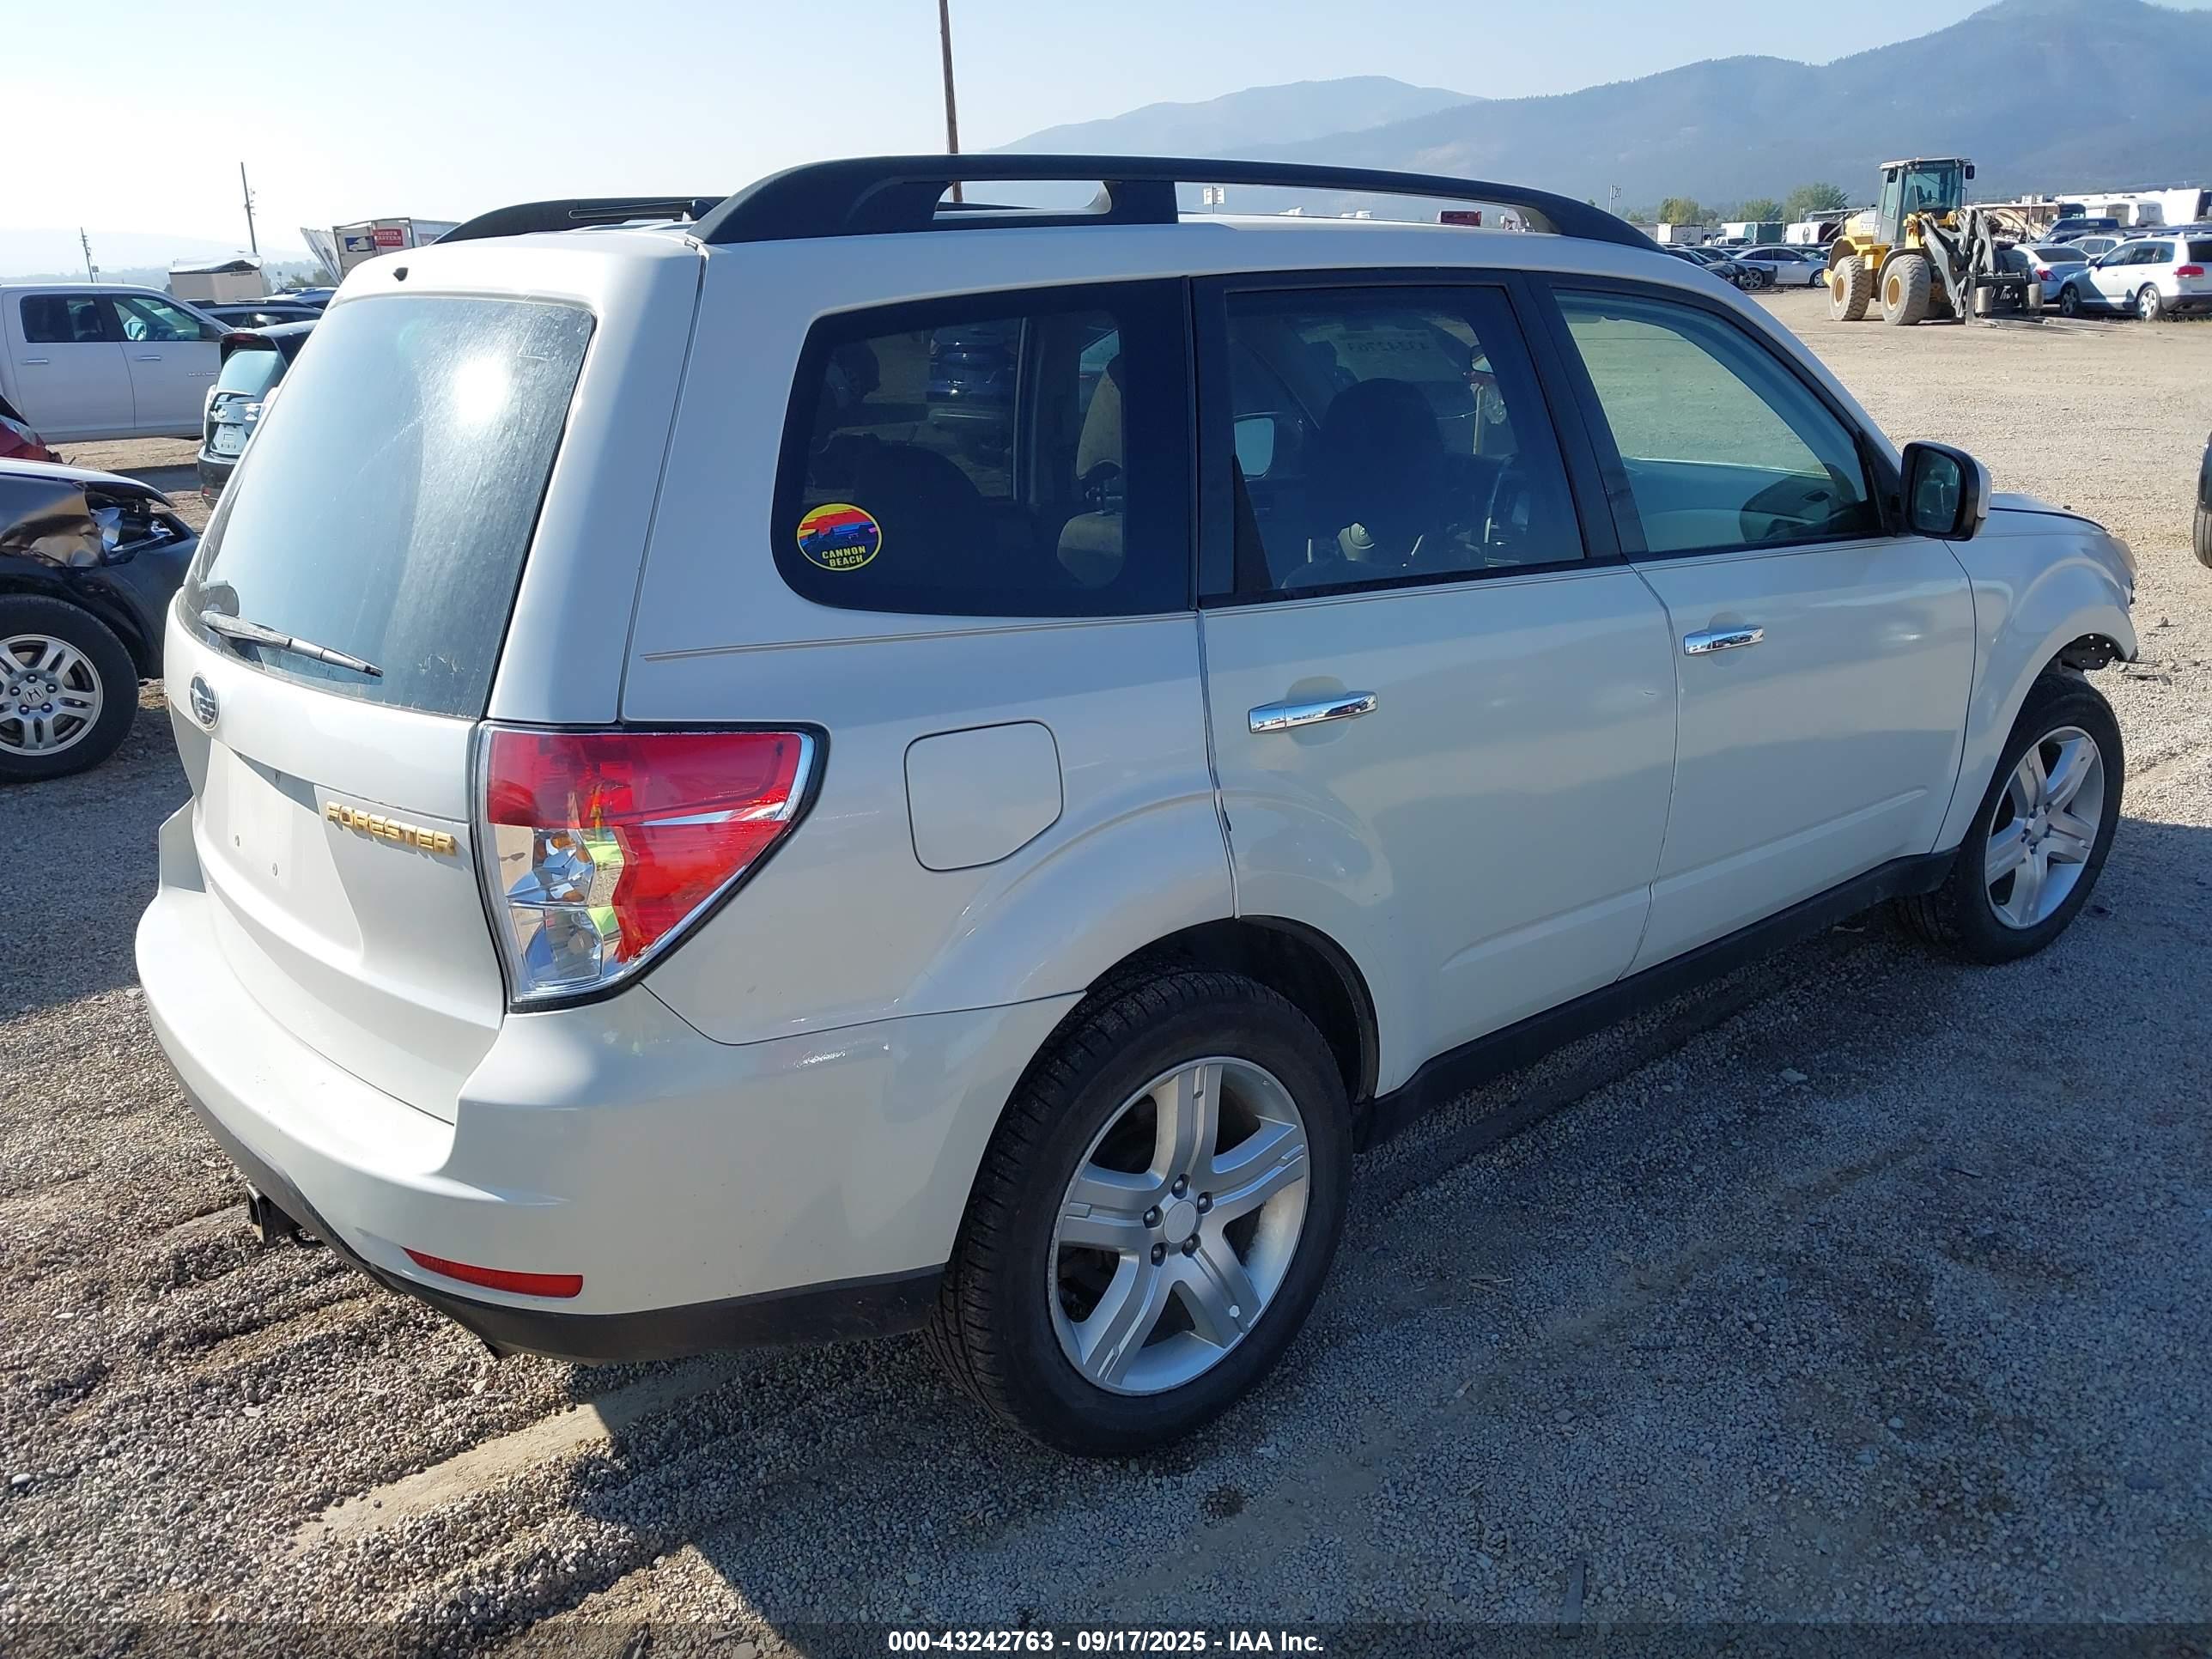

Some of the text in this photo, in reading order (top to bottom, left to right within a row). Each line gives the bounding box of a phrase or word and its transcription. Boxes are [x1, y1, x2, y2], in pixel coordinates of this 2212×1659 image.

[822, 545, 866, 560] CANNON
[829, 554, 864, 568] BEACH
[325, 800, 457, 856] FORESTER
